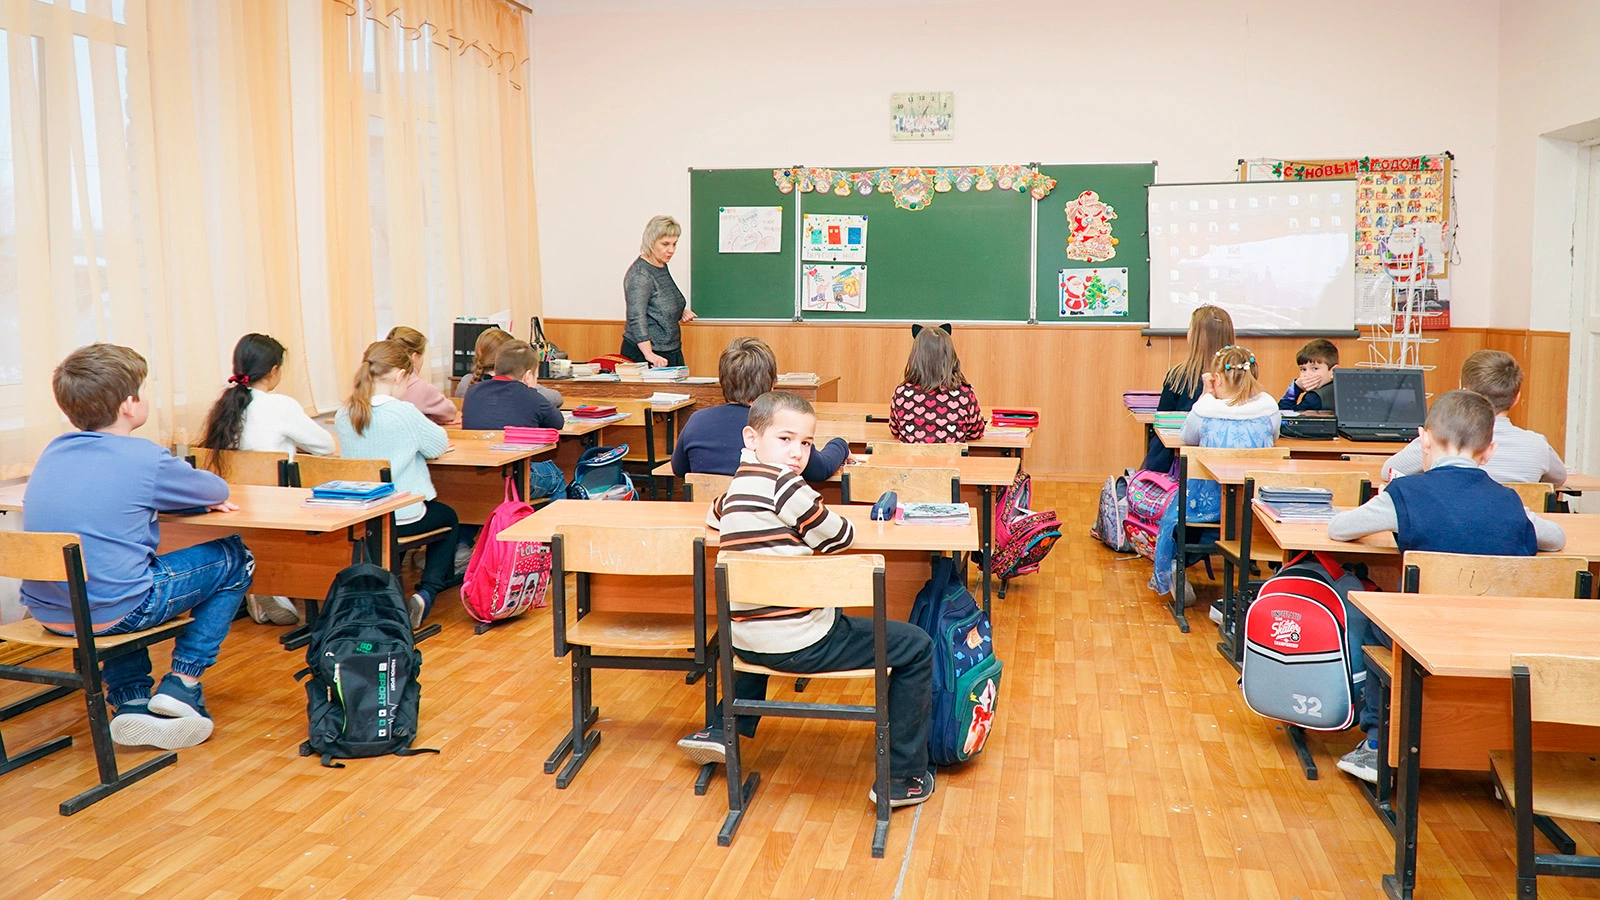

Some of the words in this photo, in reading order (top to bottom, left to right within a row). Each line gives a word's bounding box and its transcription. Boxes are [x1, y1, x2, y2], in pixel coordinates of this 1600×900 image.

[1283, 166, 1294, 178] С
[1305, 159, 1359, 179] НОВЫМ
[1293, 694, 1322, 718] 32
